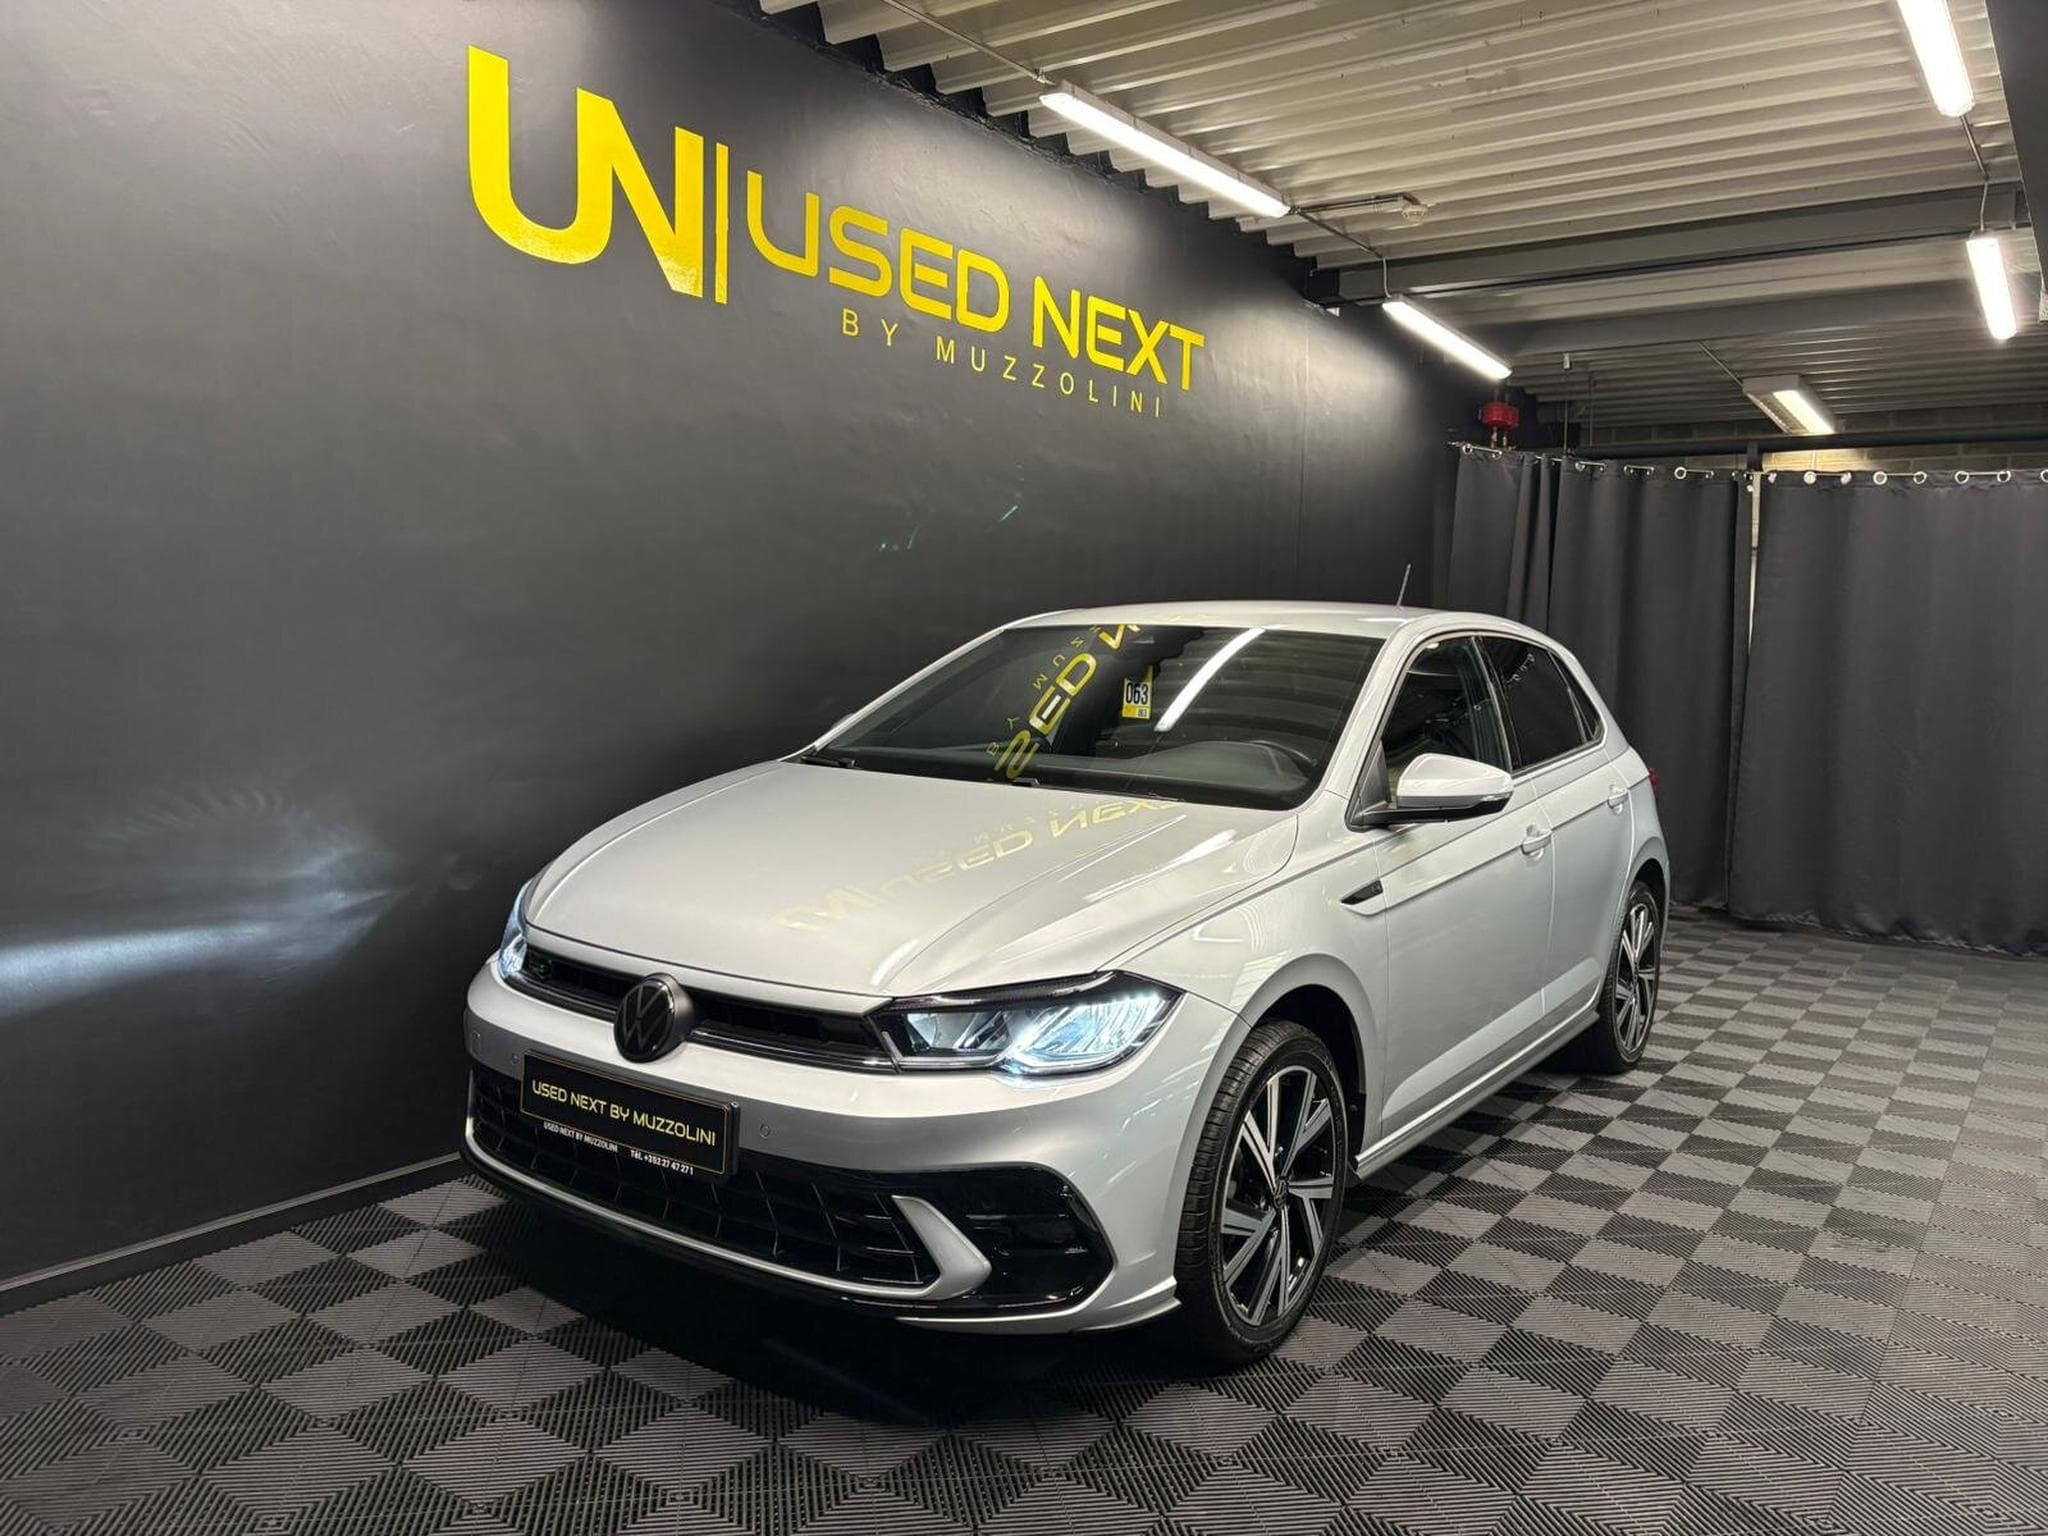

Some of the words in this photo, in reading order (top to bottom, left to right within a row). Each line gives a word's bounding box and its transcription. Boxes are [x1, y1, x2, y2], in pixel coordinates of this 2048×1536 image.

[746, 170, 1011, 333] USED
[1031, 275, 1205, 390] NEXT
[840, 308, 900, 347] BY
[935, 335, 1163, 418] MUZZOLINI
[1126, 681, 1149, 705] 063
[532, 1080, 567, 1104] USED
[570, 1092, 607, 1115] NEXT
[609, 1103, 630, 1122] BY
[633, 1110, 716, 1147] MUZZOLINI
